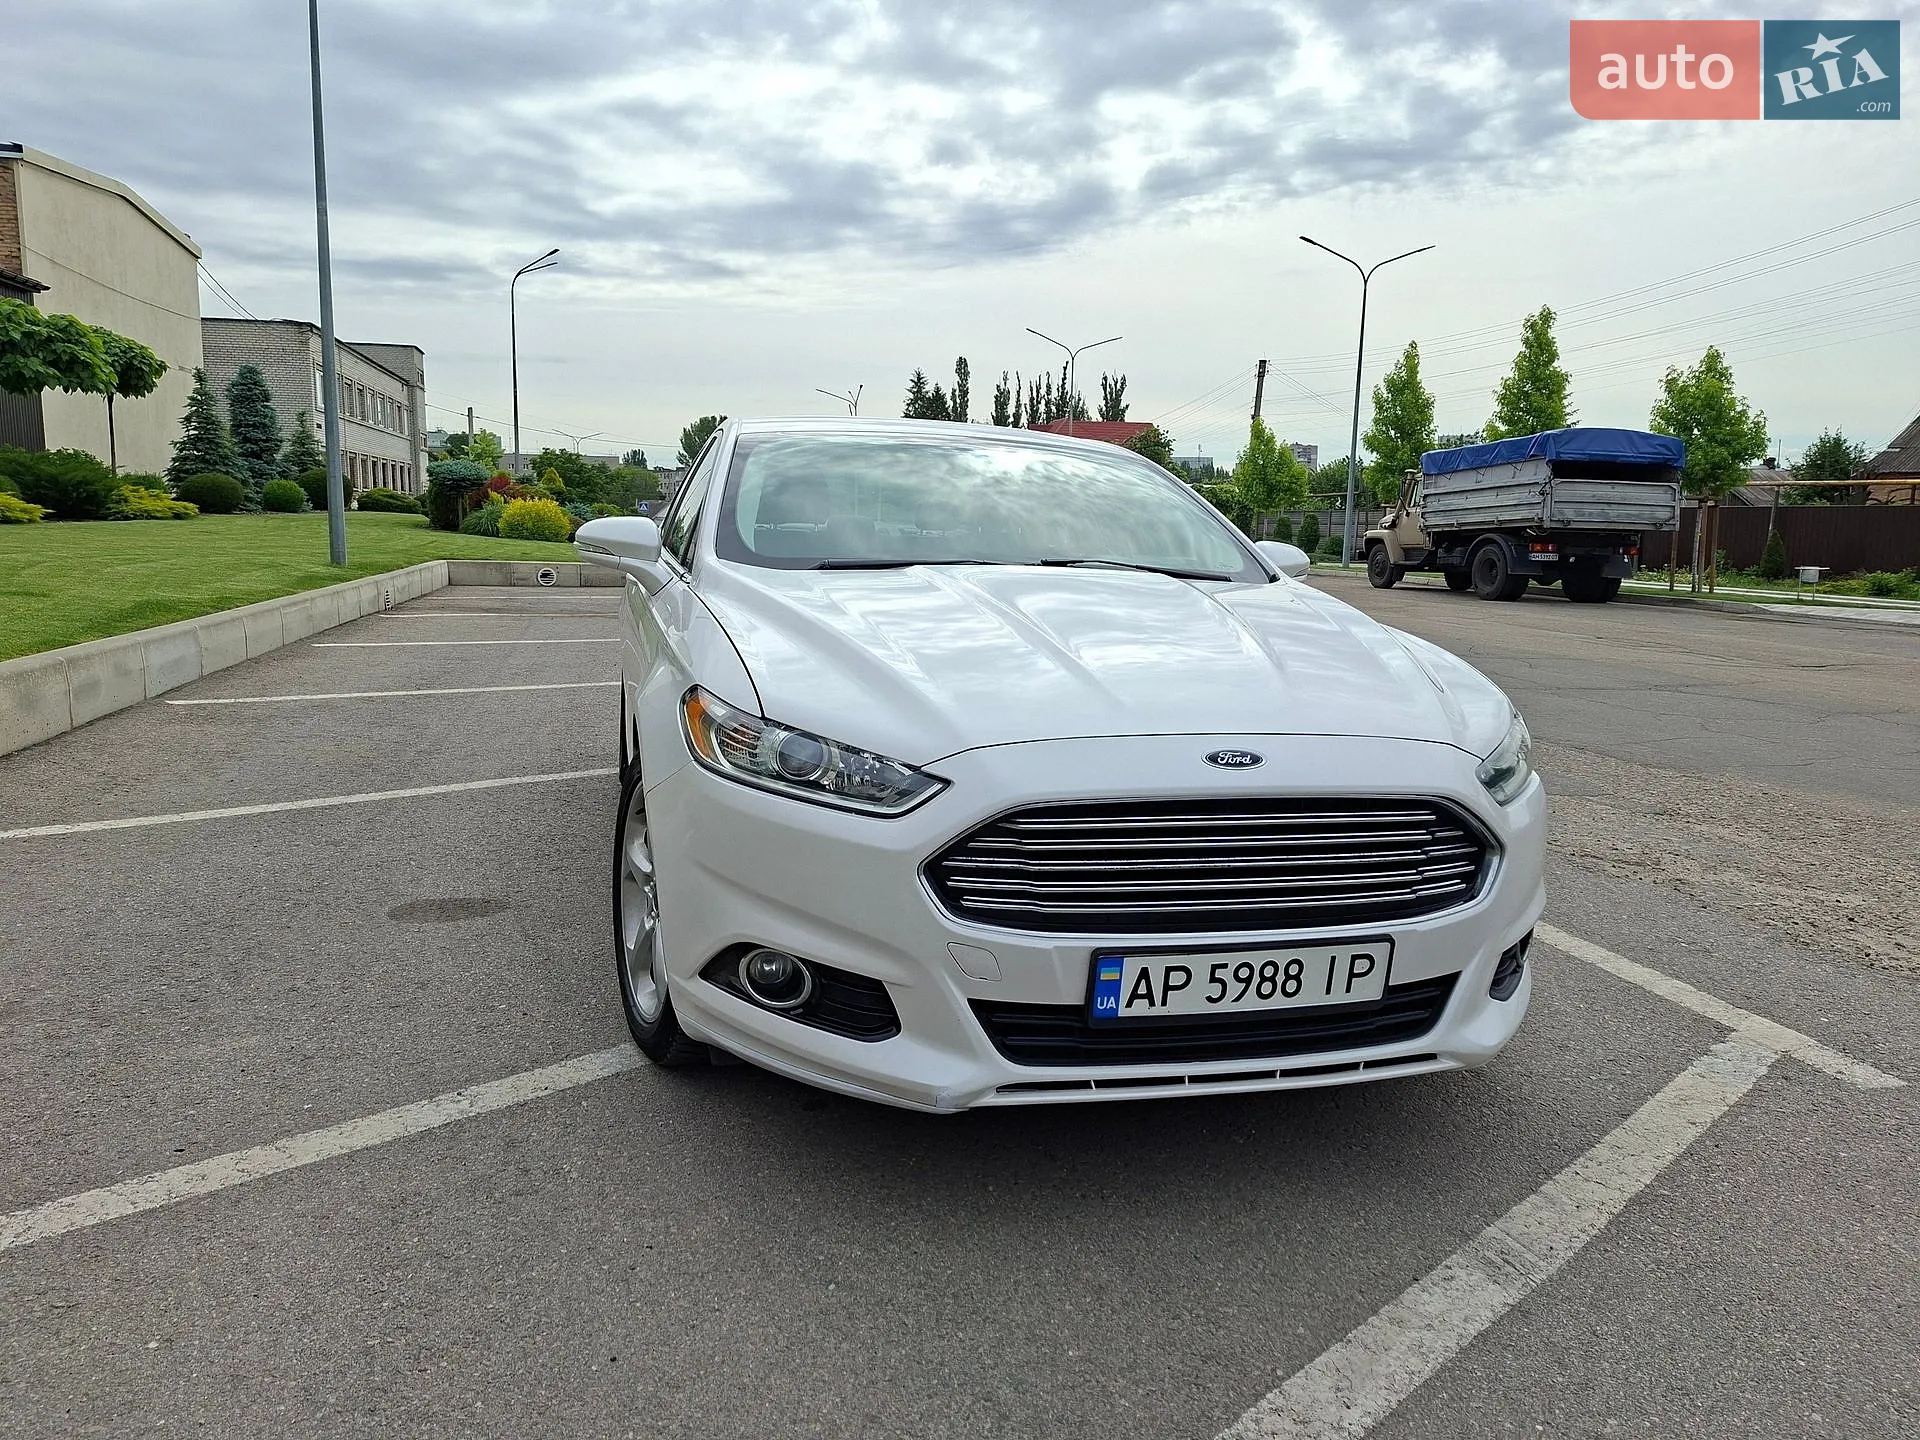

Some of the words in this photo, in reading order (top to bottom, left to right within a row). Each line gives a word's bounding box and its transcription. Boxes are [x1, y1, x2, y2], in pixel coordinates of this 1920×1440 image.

[1217, 751, 1253, 764] Ford
[1124, 964, 1193, 1009] AP
[1204, 957, 1305, 1005] 5988
[1324, 952, 1376, 996] IP
[1096, 996, 1117, 1010] UA
